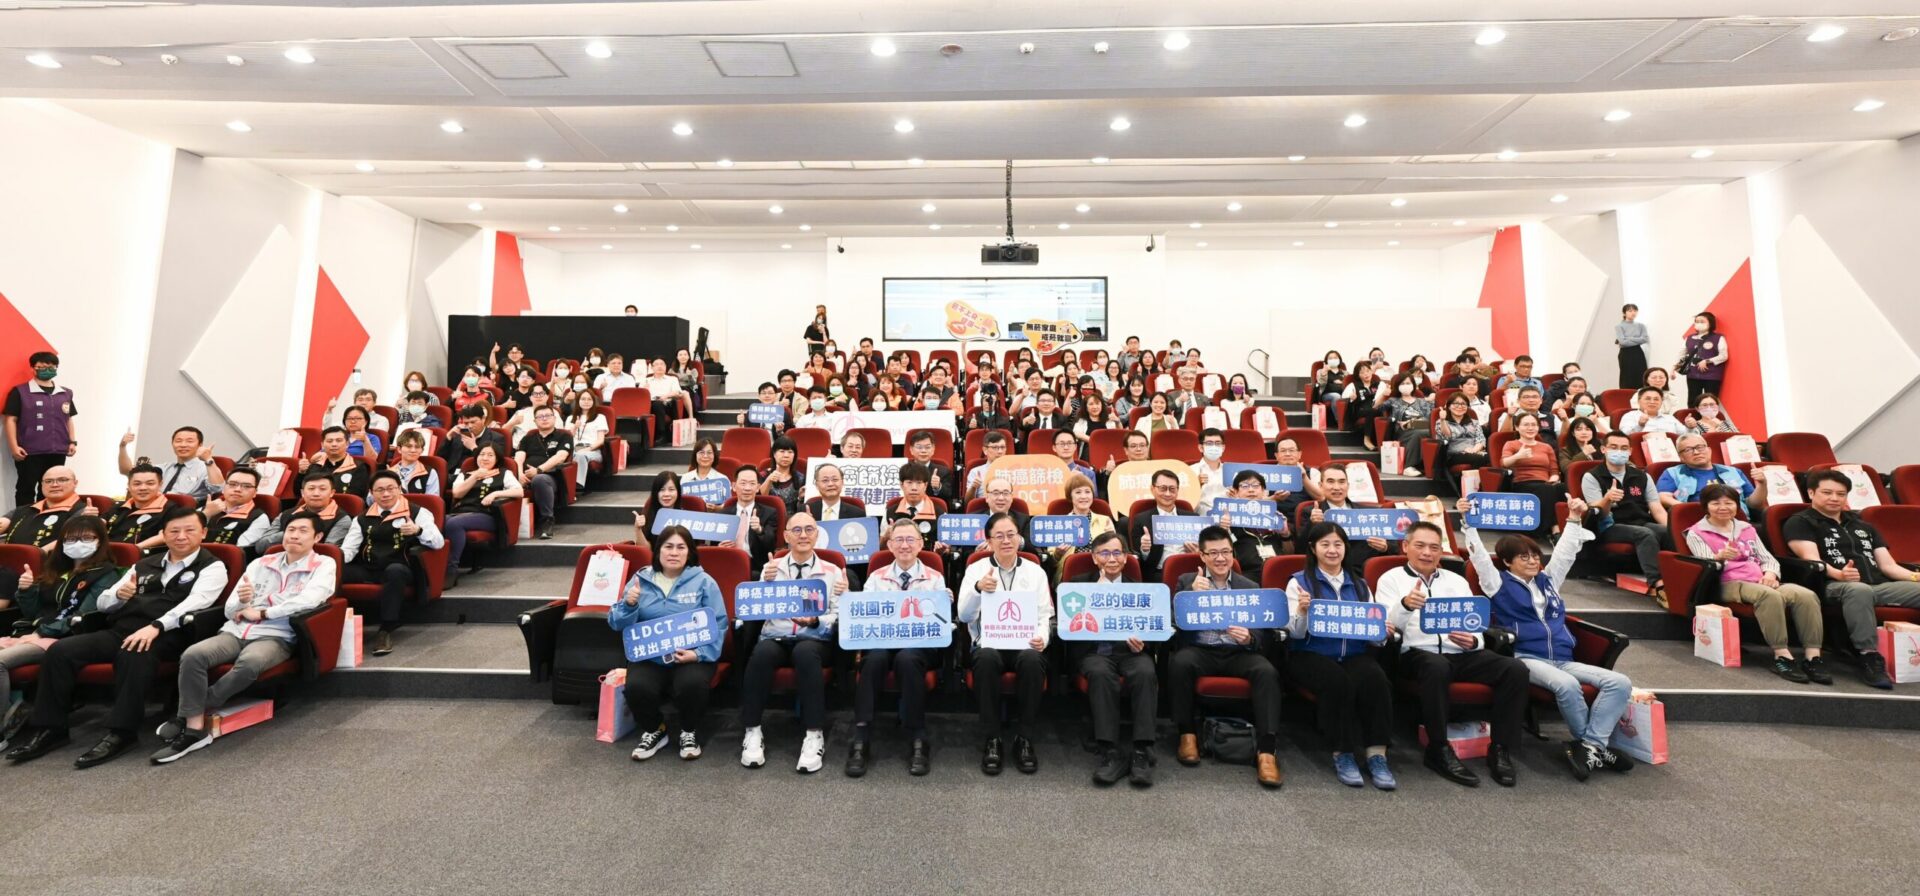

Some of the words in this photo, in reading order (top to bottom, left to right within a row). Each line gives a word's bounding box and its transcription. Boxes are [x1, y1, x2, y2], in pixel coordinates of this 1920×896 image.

[814, 464, 900, 487] 癌篩檢
[995, 467, 1063, 486] 肺癌篩檢
[843, 487, 901, 506] 護健康
[1481, 498, 1535, 511] 肺癌篩檢
[1481, 513, 1535, 527] 拯救生命
[738, 585, 800, 600] 肺癌早篩檢
[1090, 592, 1152, 608] 您的健康
[1197, 594, 1261, 607] 癌篩動起來
[738, 601, 800, 616] 全家都安心
[850, 600, 896, 617] 桃園市
[1313, 603, 1367, 618] 定期篩檢
[1424, 601, 1475, 614] 疑似異常
[630, 619, 674, 641] LDCT
[849, 622, 941, 639] 擴大肺癌篩檢
[1103, 615, 1164, 631] 由我守護
[1313, 619, 1380, 637] 擁抱健康肺
[1424, 617, 1462, 630] 要追蹤
[632, 628, 712, 658] 找出早期肺癌
